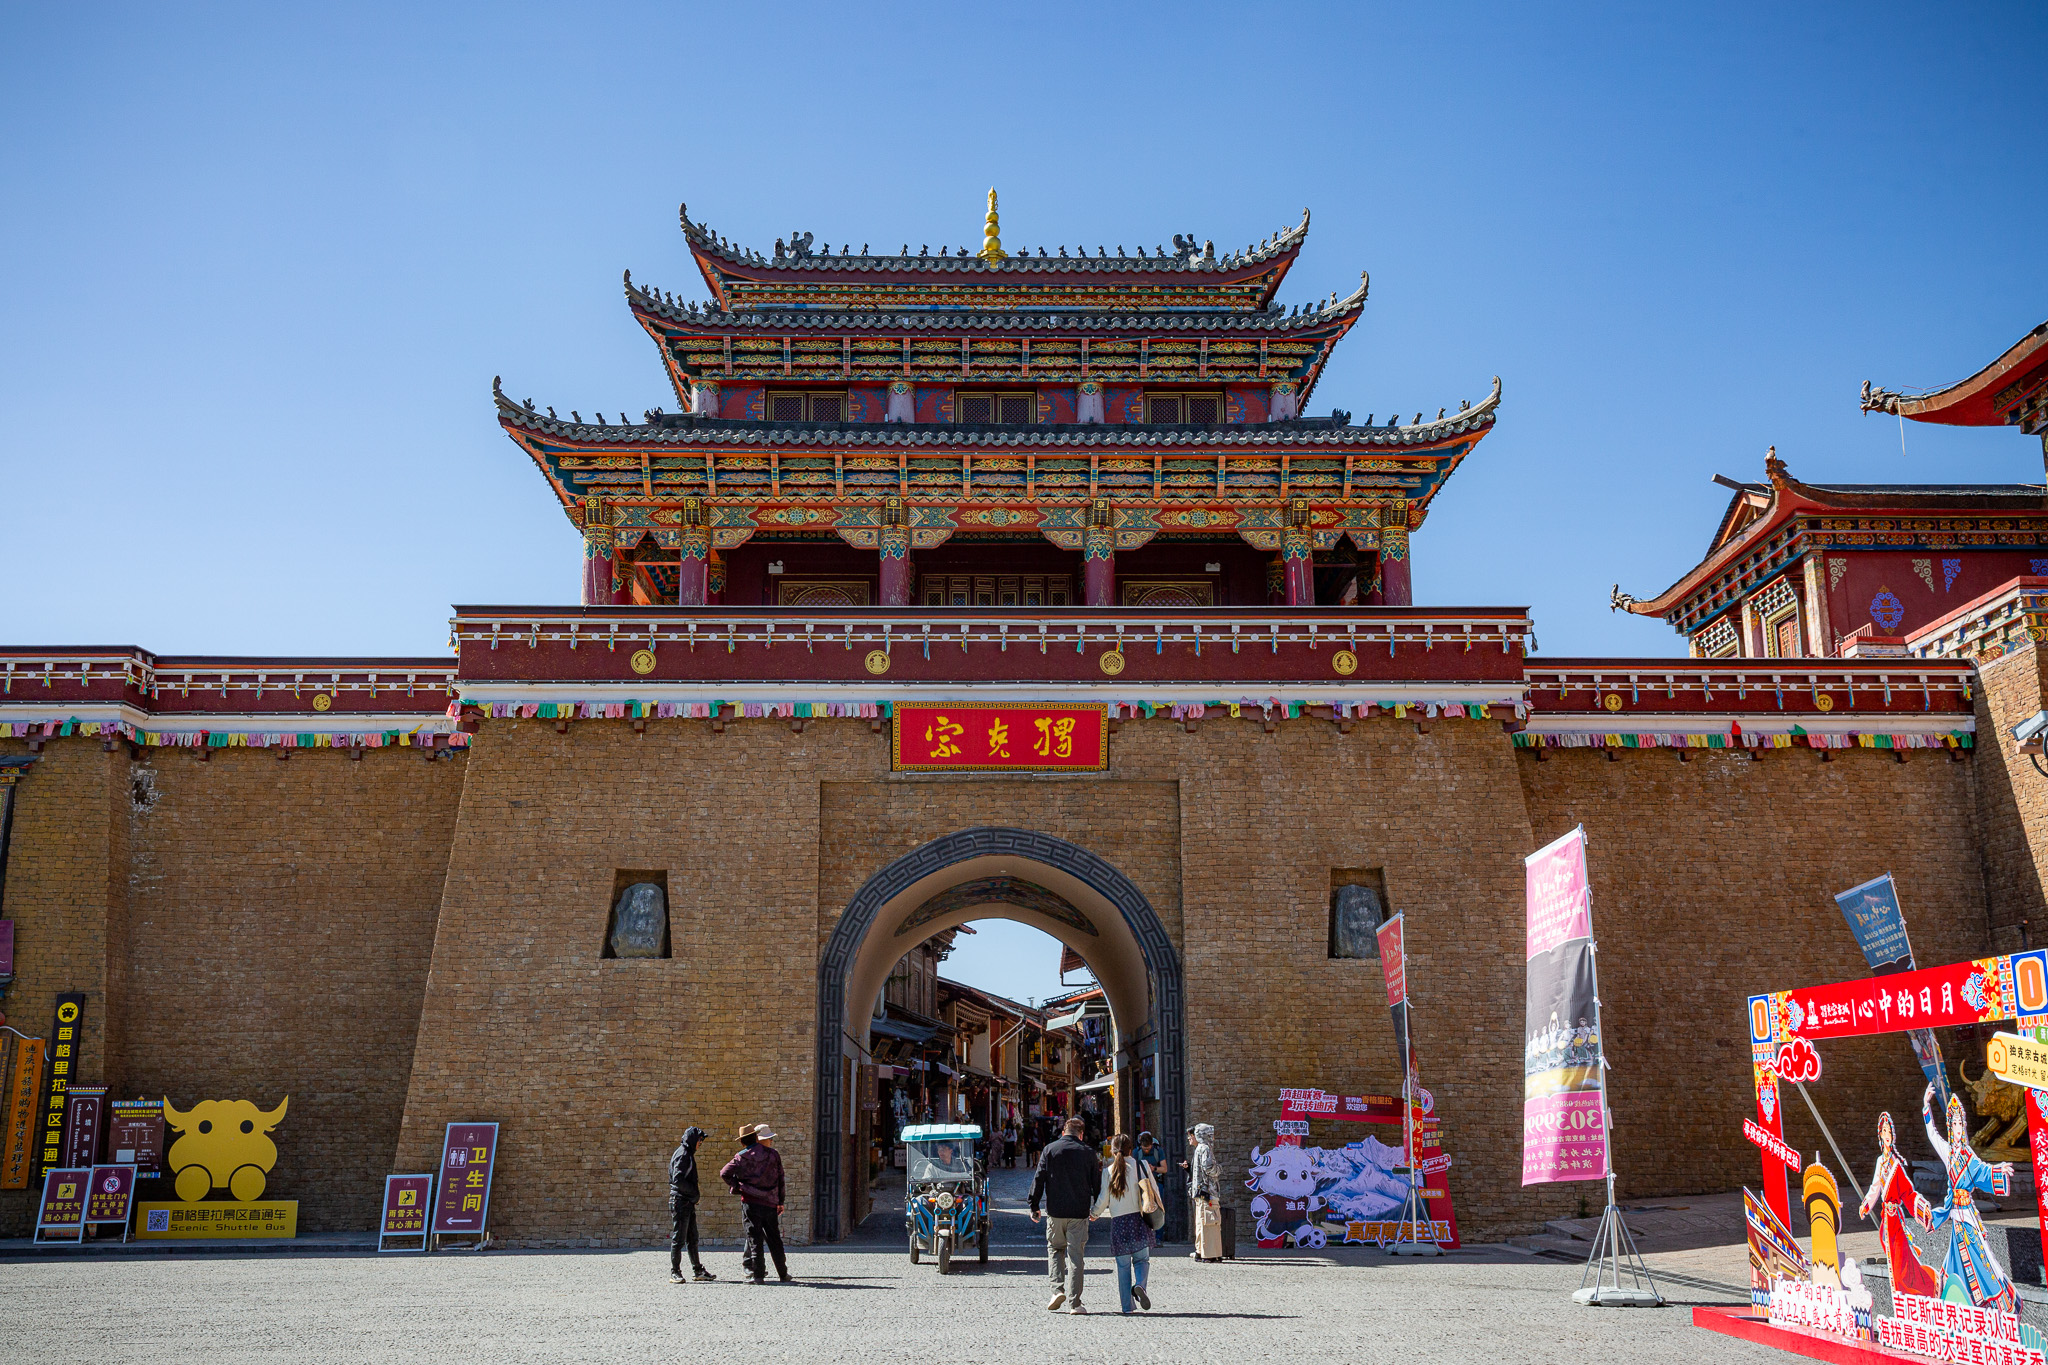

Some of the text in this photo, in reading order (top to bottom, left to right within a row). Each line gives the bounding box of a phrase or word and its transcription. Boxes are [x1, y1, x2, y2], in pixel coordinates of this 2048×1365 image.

[1858, 982, 1954, 1024] 心中的日月
[462, 1147, 488, 1212] 卫生间
[46, 1202, 81, 1211] 雨雪天气
[1285, 1201, 1306, 1211] 迪庆
[44, 1213, 80, 1222] 当心滑倒
[171, 1208, 287, 1222] 香格里拉景区直通车
[388, 1209, 423, 1218] 雨雪天气
[216, 1223, 259, 1231] Shuttle
[265, 1223, 286, 1231] Bus
[387, 1220, 422, 1229] 当心滑倒
[1893, 1294, 2019, 1343] 吉尼斯世界记录认证
